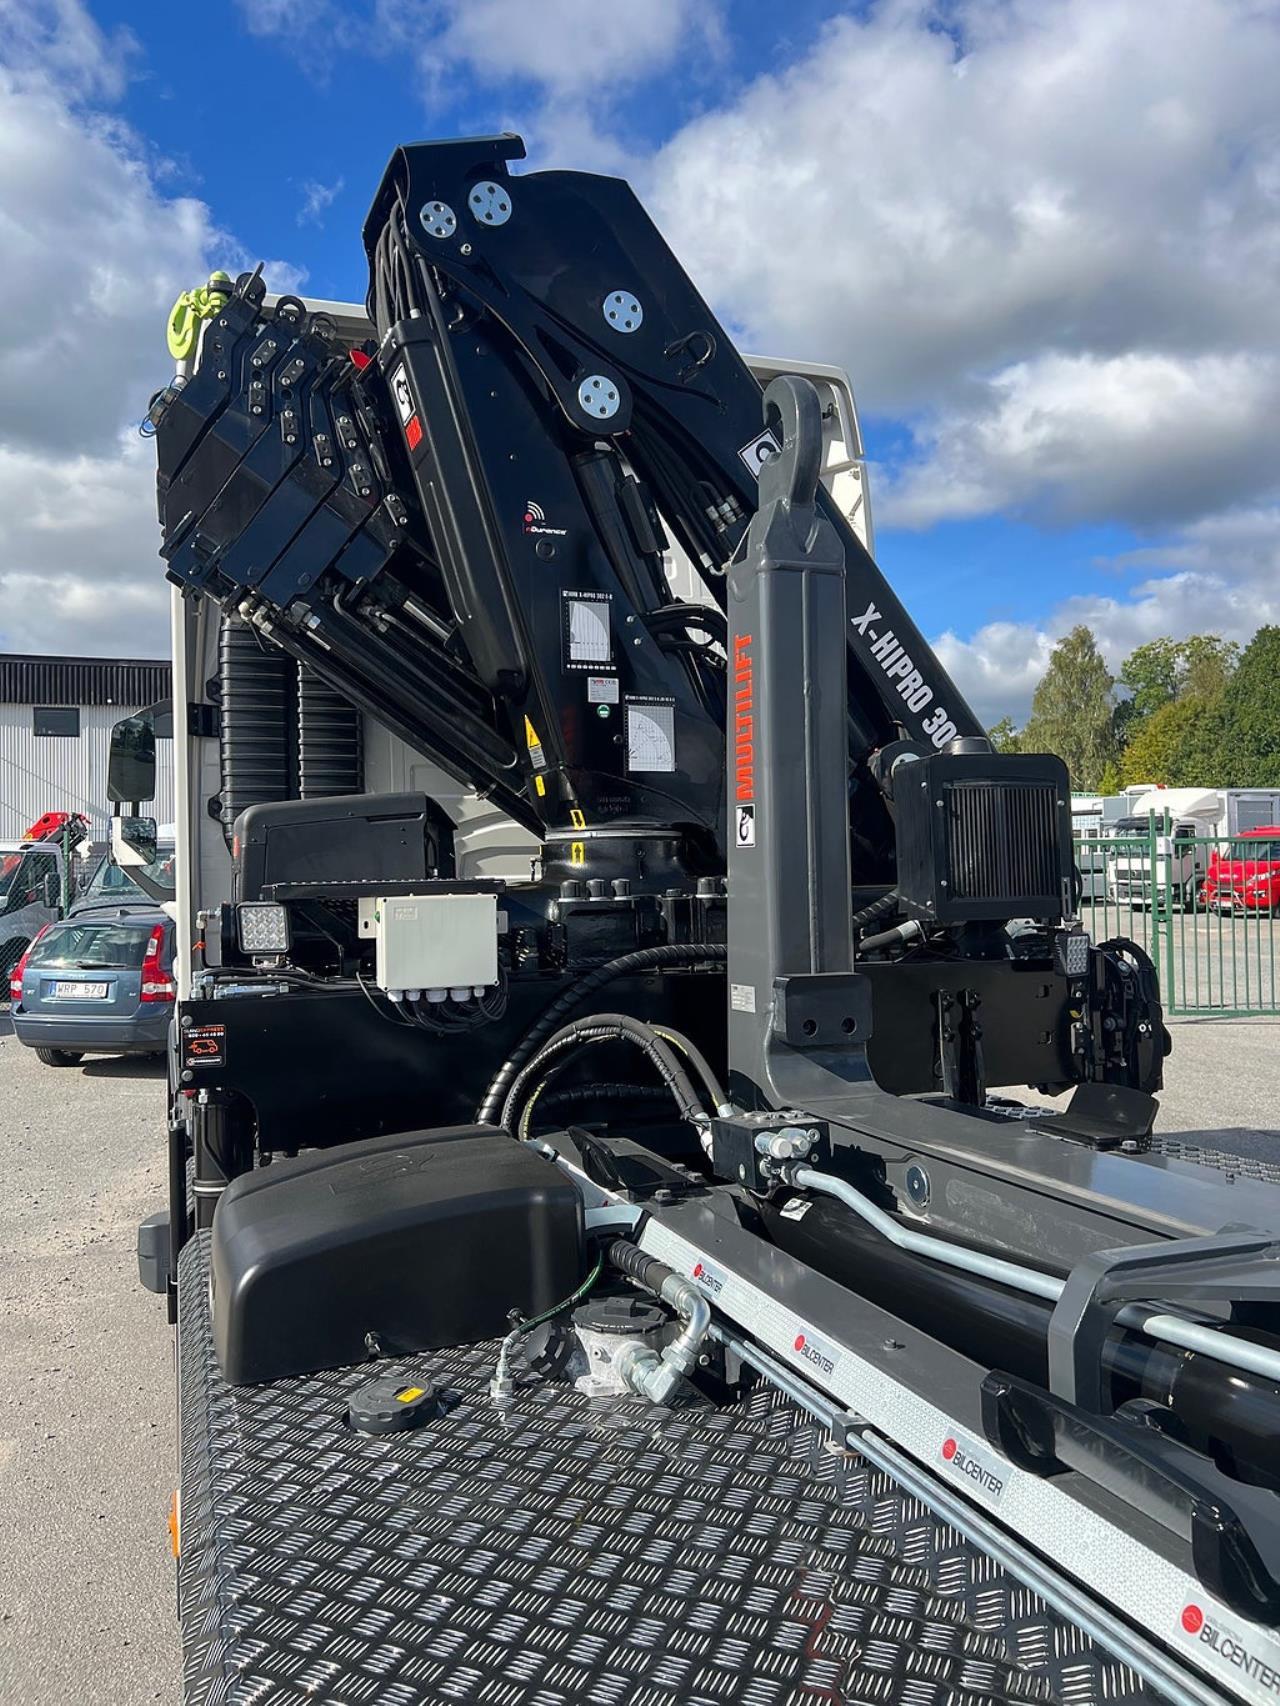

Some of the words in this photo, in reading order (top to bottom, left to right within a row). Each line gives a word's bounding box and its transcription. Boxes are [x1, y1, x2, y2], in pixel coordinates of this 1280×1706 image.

[850, 602, 934, 714] X-HIPRO
[921, 706, 963, 750] 30
[734, 633, 754, 801] MULTILIFT
[58, 983, 77, 993] WRP
[84, 984, 105, 994] 570
[698, 1270, 724, 1294] BILCENTER
[800, 1343, 835, 1376] BILCENTER
[951, 1451, 1004, 1497] BILCENTER
